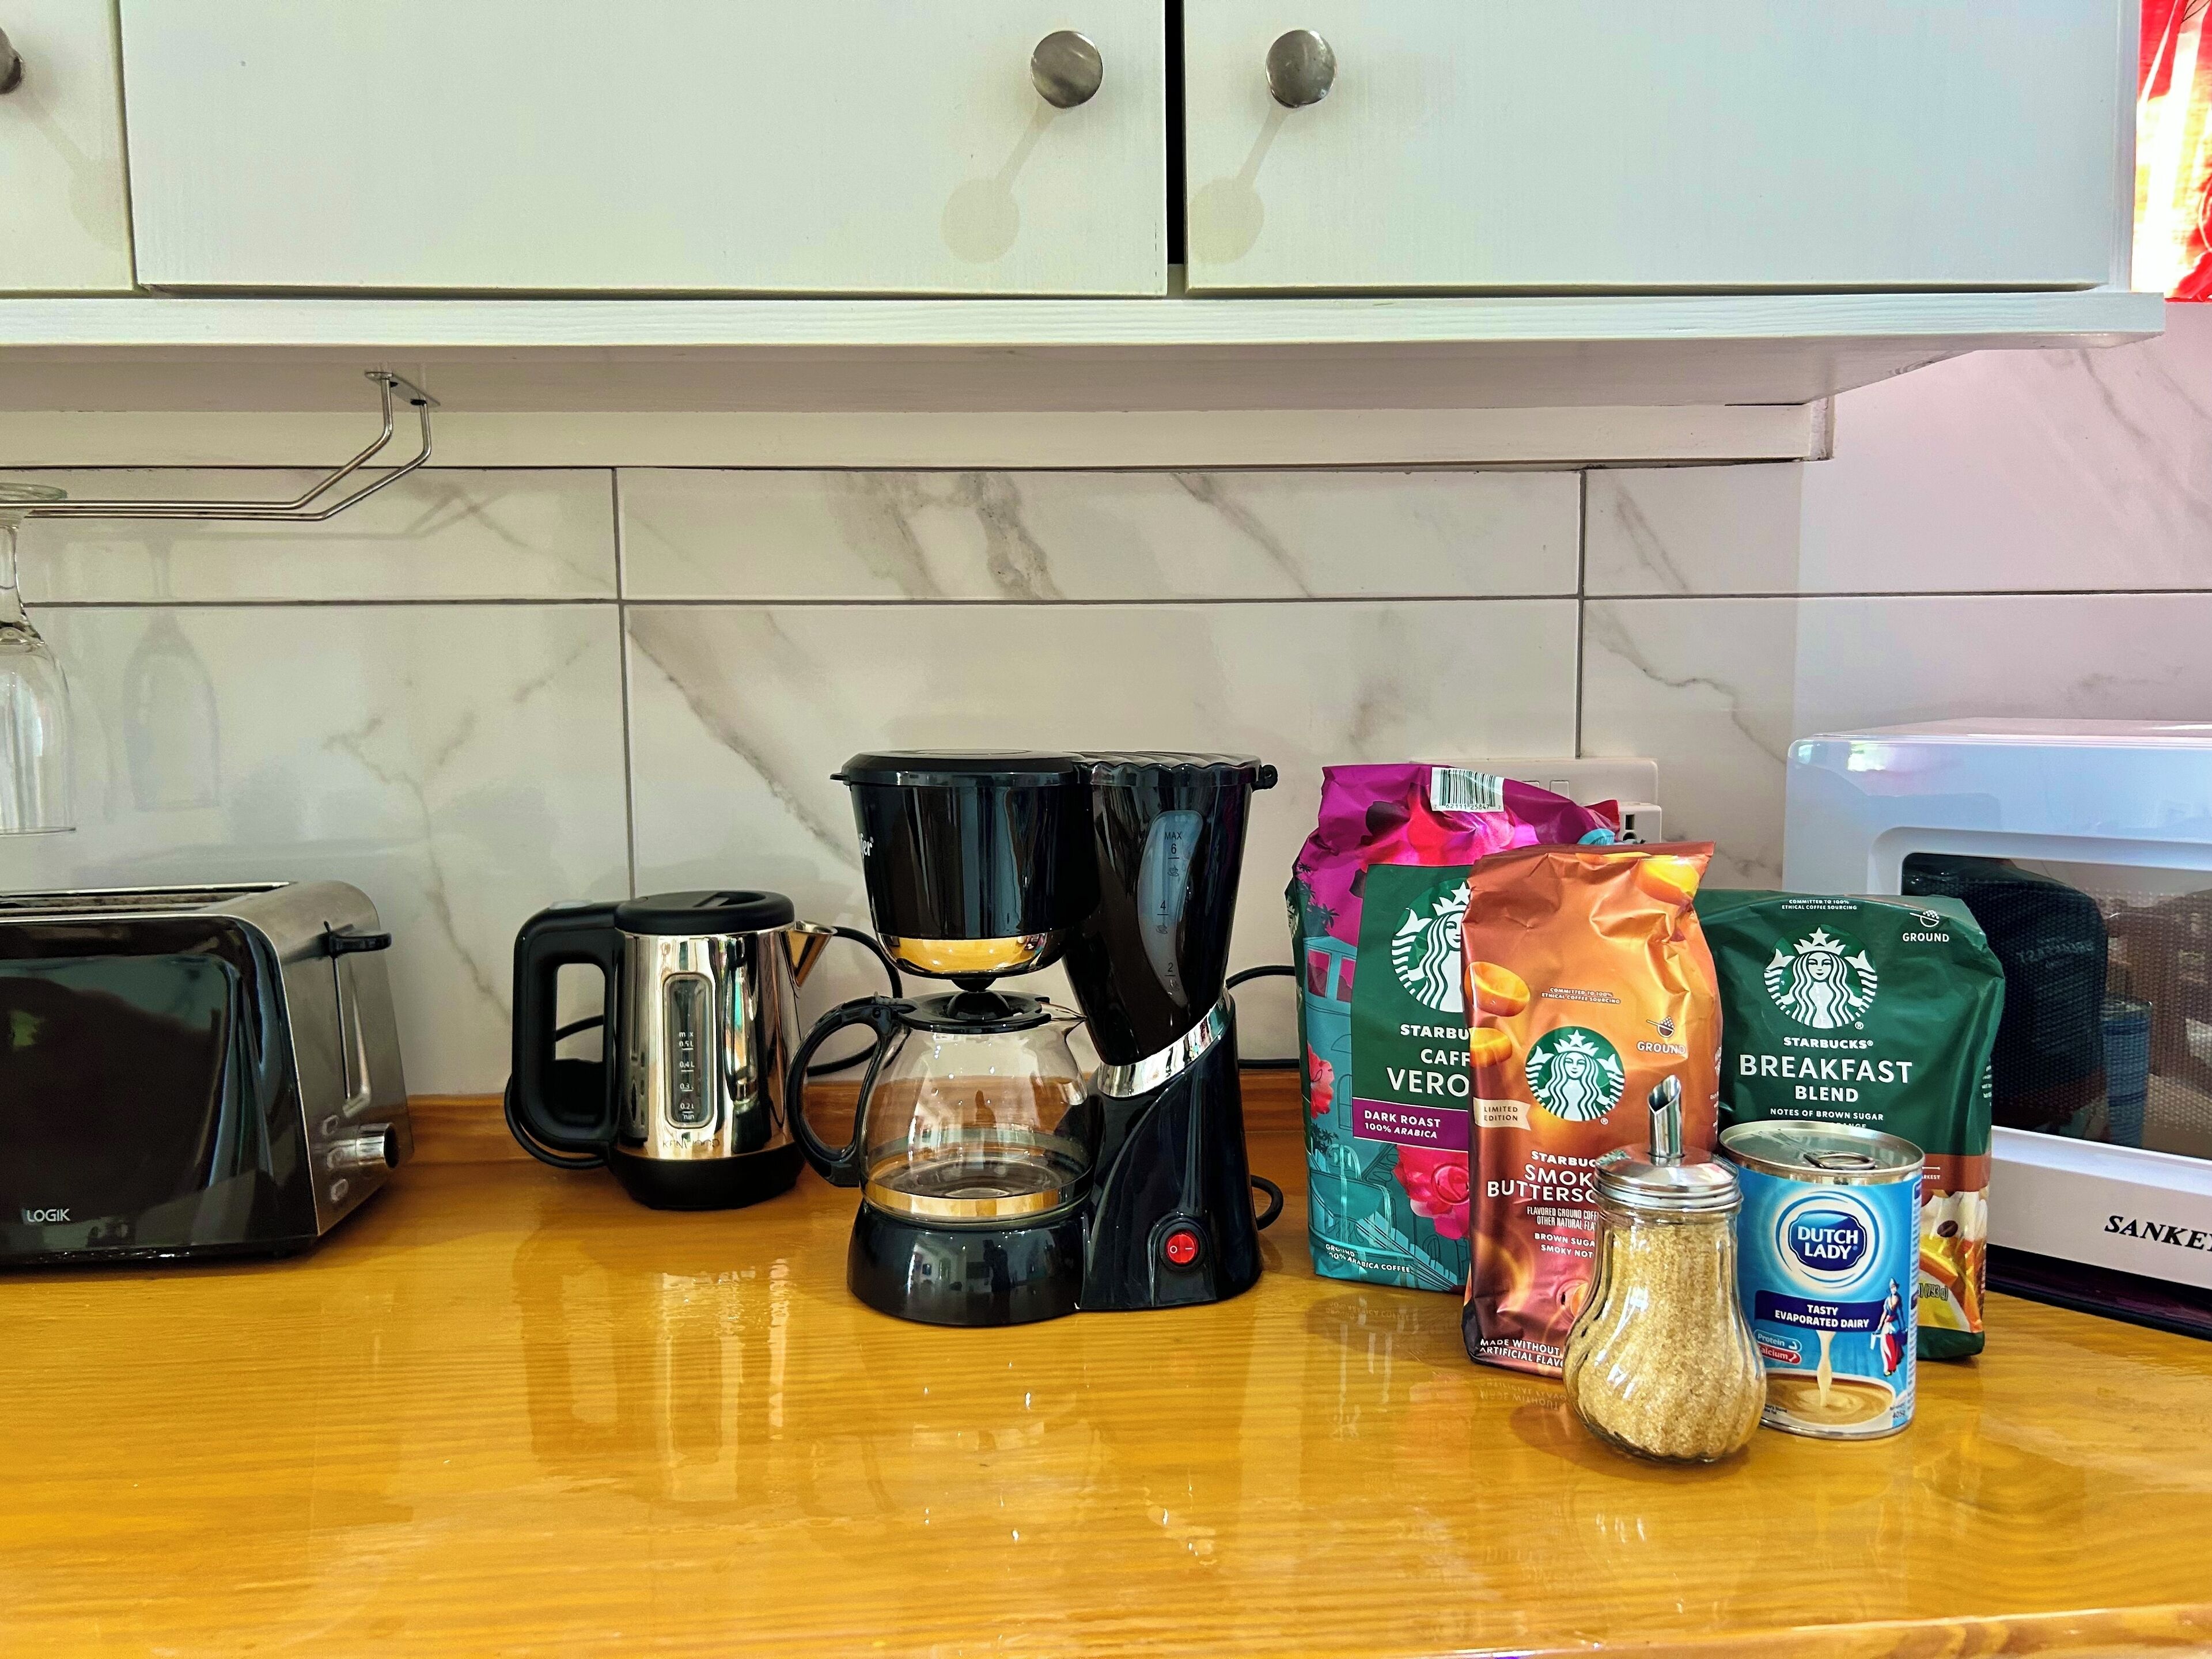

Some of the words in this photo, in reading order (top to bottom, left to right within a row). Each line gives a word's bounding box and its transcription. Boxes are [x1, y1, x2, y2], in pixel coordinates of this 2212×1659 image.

[1164, 832, 1182, 840] MAX
[1171, 843, 1177, 854] 6
[1160, 900, 1166, 911] 4
[1902, 932, 1949, 943] GROUND
[1167, 962, 1173, 972] 2
[1550, 987, 1585, 995] COMMITTED
[1589, 997, 1620, 1005] SOURCING
[1400, 1024, 1469, 1040] STARBU
[1637, 1040, 1686, 1055] GROUND
[1420, 1048, 1470, 1067] CAFF
[1739, 1054, 1913, 1084] BREAKFAST
[1386, 1067, 1469, 1097] VERO
[1794, 1085, 1859, 1103] BLEND
[1363, 1109, 1396, 1123] DARK
[1400, 1113, 1441, 1128] ROAST
[1770, 1108, 1800, 1116] NOTES
[1816, 1111, 1851, 1119] BROWN
[1853, 1112, 1884, 1121] SUGAR
[1365, 1122, 1392, 1134] 100%
[1393, 1126, 1438, 1139] ARABICA
[1524, 1164, 1593, 1188] SMOK
[26, 1209, 71, 1222] LOGIK
[1527, 1206, 1556, 1217] FLAVORED
[1557, 1207, 1582, 1219] GROUND
[1584, 1209, 1599, 1221] COFF
[1536, 1215, 1555, 1226] OTHER
[1556, 1217, 1583, 1230] NATURAL
[1534, 1233, 1568, 1244] BROWN
[1571, 1237, 1595, 1248] SUGA
[1797, 1225, 1858, 1244] DUTCH
[2104, 1215, 2212, 1252] SANKE
[1325, 1244, 1355, 1258] GROUND
[1540, 1244, 1572, 1255] SMOKY
[1574, 1249, 1594, 1259] NOT
[1804, 1242, 1852, 1260] LADY
[1347, 1255, 1379, 1270] ARABICA
[1381, 1264, 1411, 1273] COFFEE
[1807, 1304, 1839, 1316] TASTY
[1775, 1309, 1839, 1328] EVAPORATED
[1840, 1319, 1870, 1328] DAIRY
[1480, 1339, 1509, 1347] MADE
[1512, 1339, 1560, 1356] WITHOUT
[1758, 1333, 1785, 1347] Protein
[1479, 1346, 1533, 1362] ARTIFICIAL
[1759, 1346, 1789, 1360] alcium
